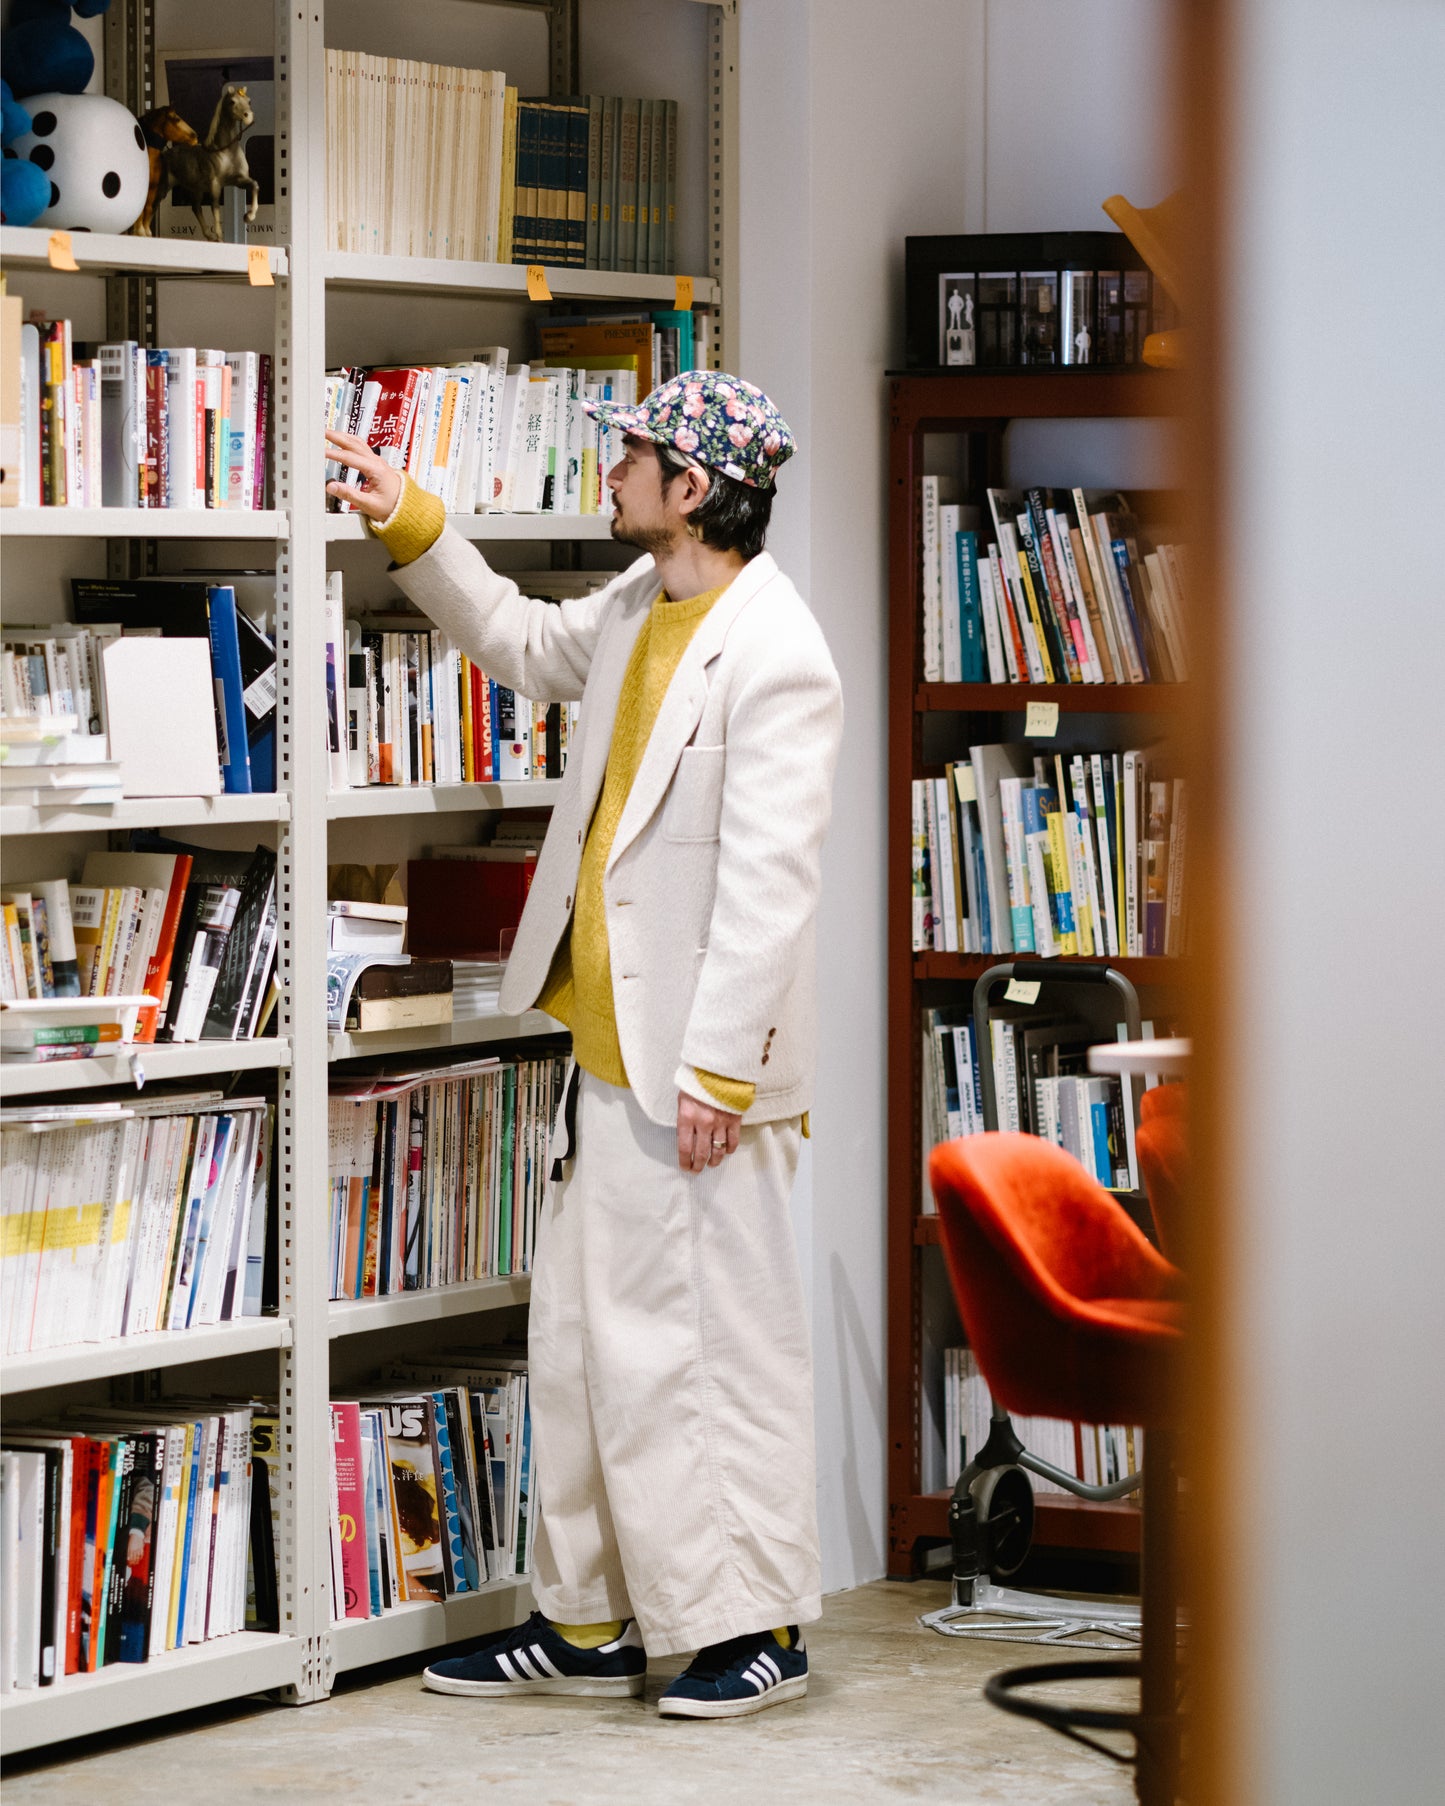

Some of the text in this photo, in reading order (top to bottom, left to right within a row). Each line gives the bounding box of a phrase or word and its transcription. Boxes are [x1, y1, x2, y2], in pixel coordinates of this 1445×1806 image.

[604, 328, 650, 340] PRESIDENT
[526, 413, 542, 453] 経営
[1027, 549, 1038, 573] 2021
[1039, 796, 1061, 817] Sof
[193, 874, 248, 887] ZANINE
[1004, 1035, 1016, 1093] ELMGREEN
[138, 1442, 150, 1454] 51
[155, 1439, 164, 1470] PLUG
